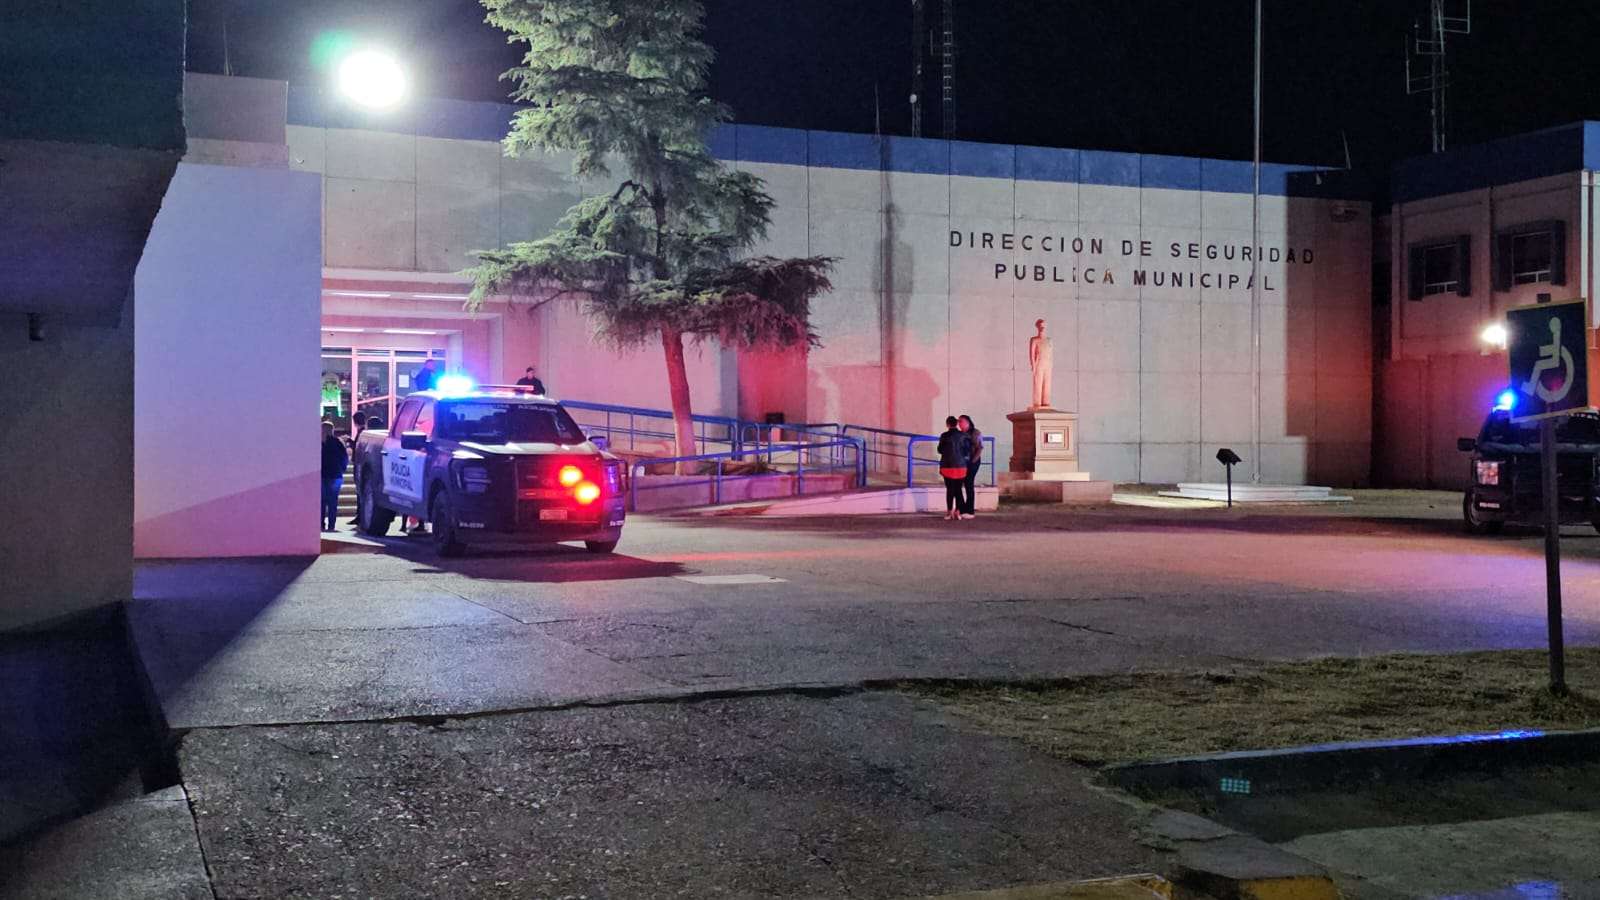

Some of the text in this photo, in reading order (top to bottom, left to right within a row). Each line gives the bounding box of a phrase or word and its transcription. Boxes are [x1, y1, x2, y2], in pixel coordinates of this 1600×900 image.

[950, 230, 1314, 264] DIRECCION DE SEGURIDAD
[995, 264, 1114, 285] PUBLICA
